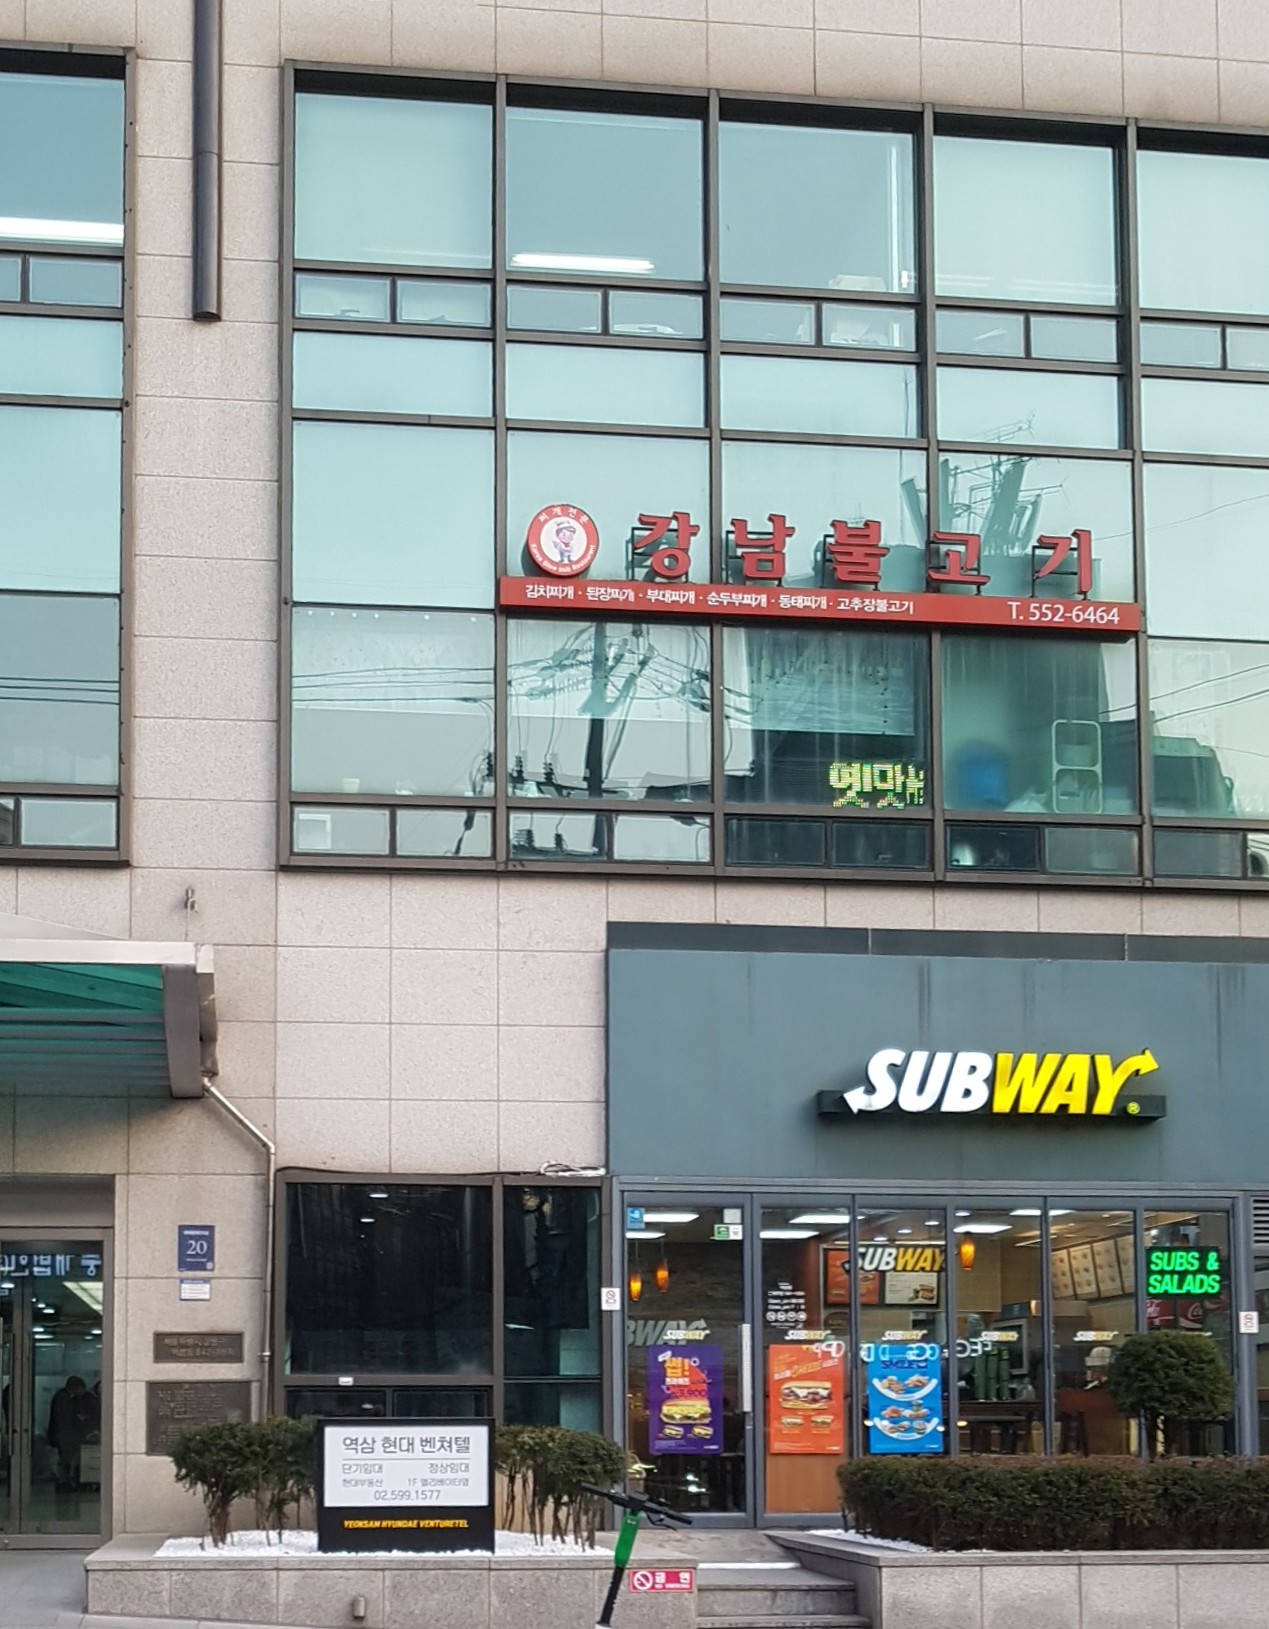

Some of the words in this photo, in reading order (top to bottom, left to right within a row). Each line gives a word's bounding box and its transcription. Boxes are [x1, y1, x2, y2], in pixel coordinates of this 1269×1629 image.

[632, 511, 1092, 594] 강남불고기
[525, 584, 574, 600] 김치찌개
[586, 586, 635, 602] 된장찌개
[646, 589, 696, 605] 부대찌개
[706, 591, 767, 608] 순두부찌개
[778, 594, 827, 609] 동태찌개
[837, 597, 914, 615] 고추장불고기
[1008, 601, 1023, 621] T.
[1028, 602, 1120, 625] 552-6464
[843, 1048, 1159, 1115] SUBWAY
[186, 1240, 208, 1255] 20
[1150, 1251, 1200, 1271] SUBS
[1206, 1251, 1220, 1271] &
[1148, 1274, 1221, 1294] SALADS
[342, 1436, 376, 1454] 역삼
[381, 1436, 414, 1454] 현대
[374, 1490, 441, 1501] 02.599.1577
